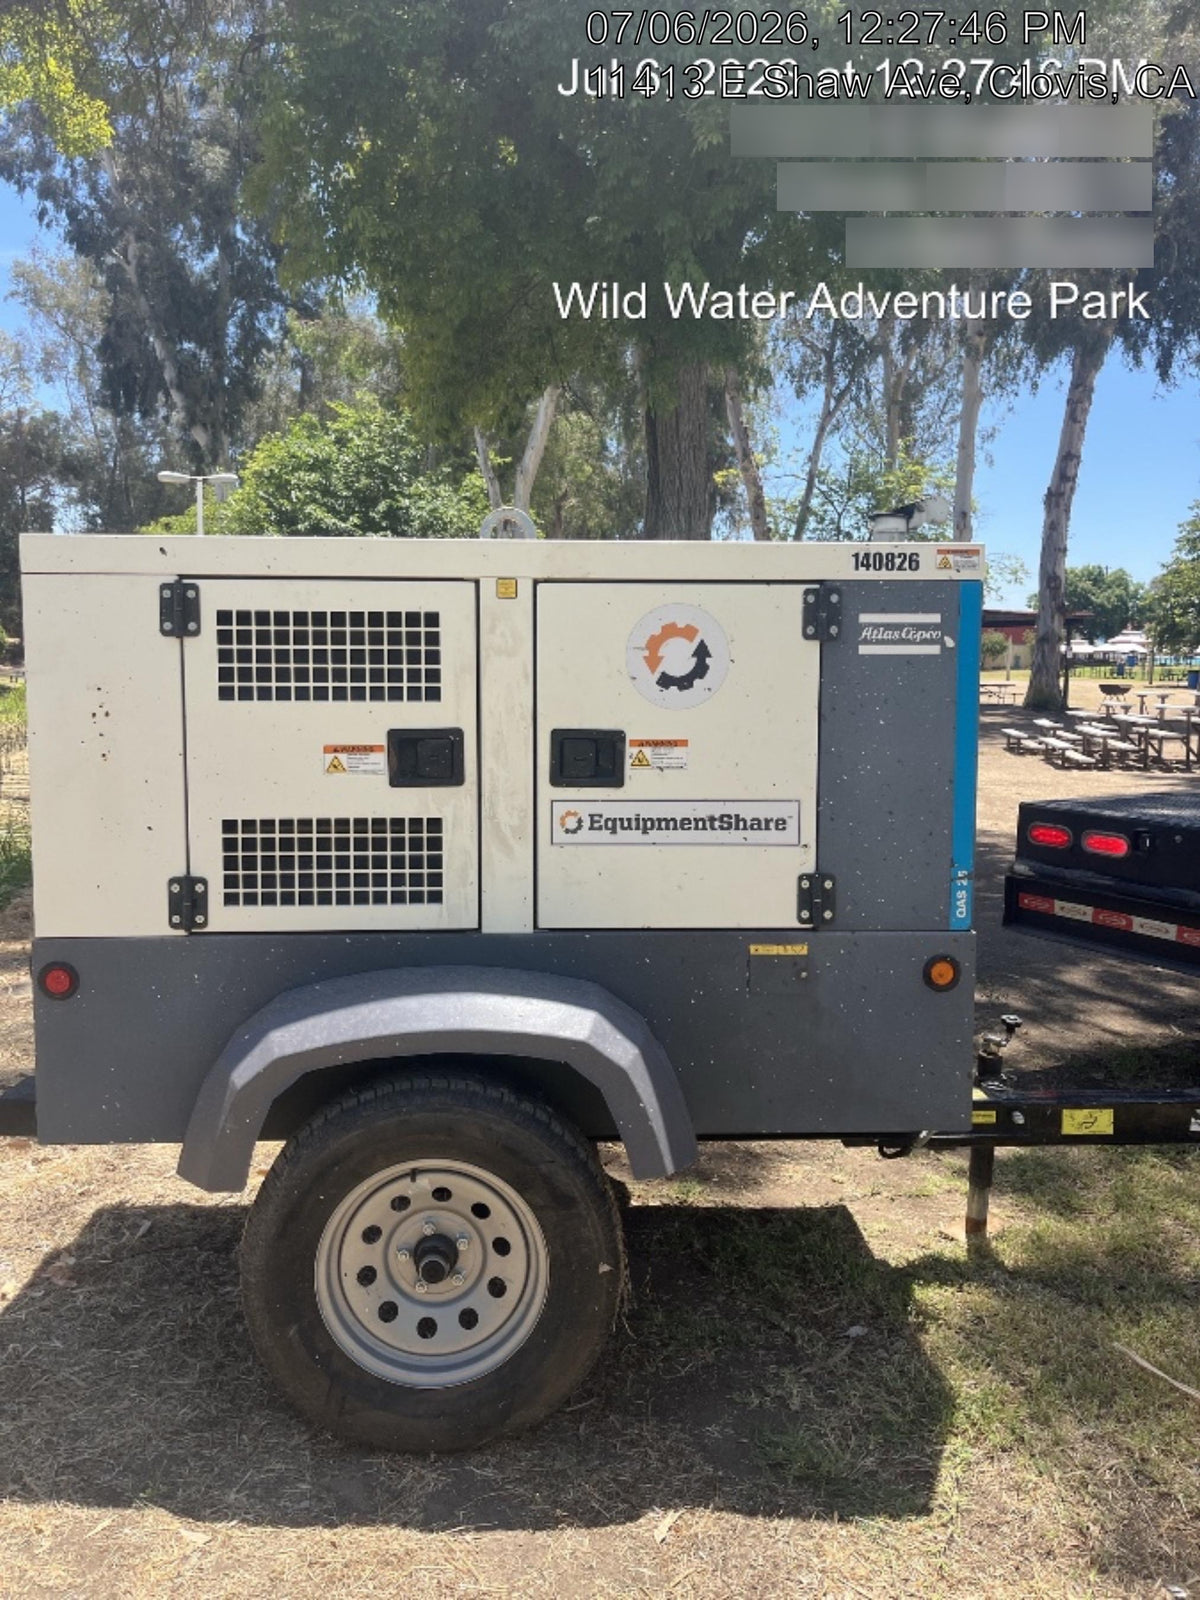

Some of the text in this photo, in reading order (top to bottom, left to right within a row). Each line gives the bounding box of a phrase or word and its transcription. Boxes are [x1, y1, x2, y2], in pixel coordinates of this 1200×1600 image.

[852, 551, 921, 572] 140826
[858, 626, 900, 643] Atlas
[588, 813, 788, 835] EquipmentShare
